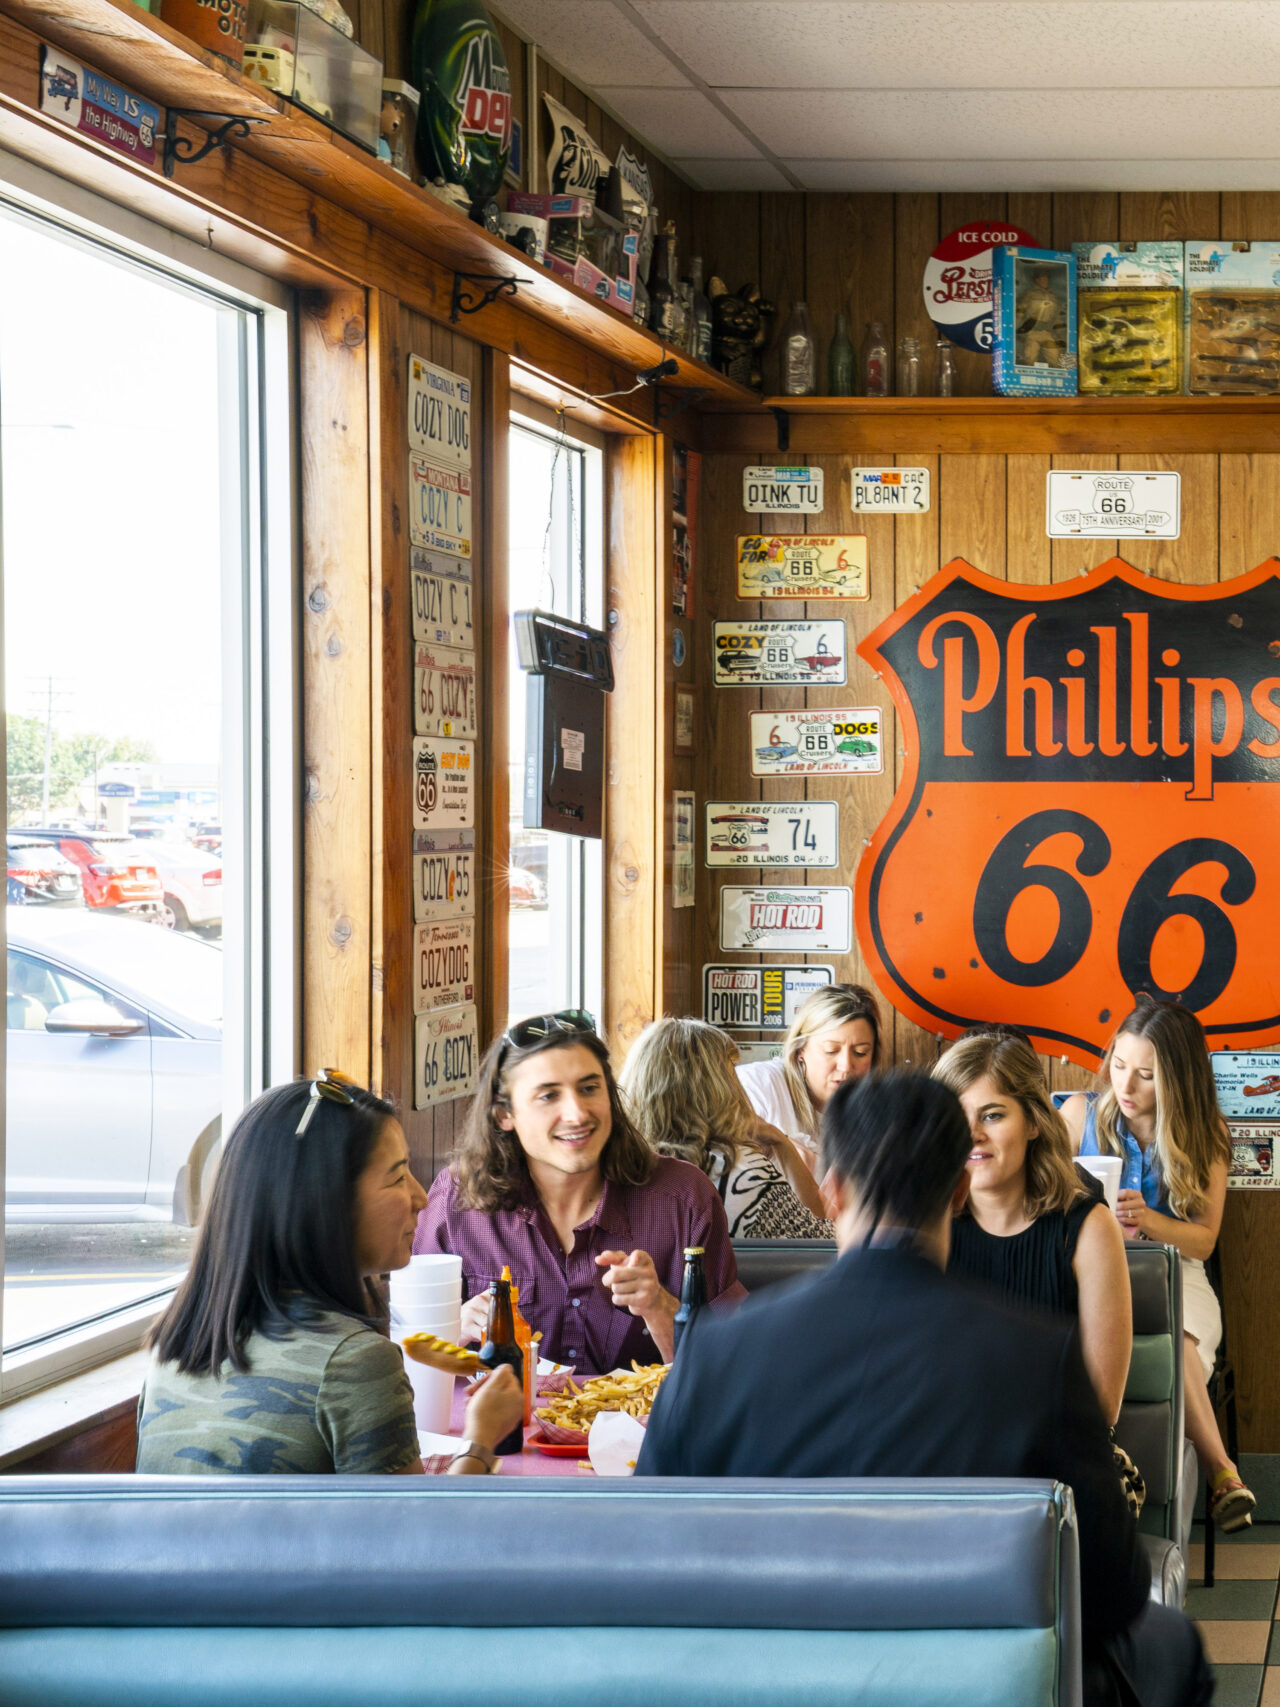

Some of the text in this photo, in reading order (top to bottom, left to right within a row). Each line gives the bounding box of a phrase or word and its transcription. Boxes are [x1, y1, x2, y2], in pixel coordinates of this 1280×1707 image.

[218, 16, 243, 43] OIL
[88, 76, 140, 118] My Way IS
[86, 106, 138, 151] the Highway
[958, 231, 1019, 243] ICE COLD
[425, 372, 456, 398] VIRGINIA
[414, 391, 469, 450] COZY DOG
[428, 468, 460, 493] MONTANA
[904, 474, 923, 484] CAL
[1098, 481, 1130, 489] ROUTE
[749, 485, 818, 503] OINK TU
[421, 485, 463, 533] COZY C
[1101, 498, 1126, 513] 66
[1101, 515, 1145, 526] ANNIVERSARY
[791, 561, 813, 576] 66
[837, 550, 848, 571] 6
[415, 575, 458, 626] COZY C
[716, 636, 766, 649] COZY
[817, 634, 828, 655] 6
[767, 649, 788, 662] 66
[421, 670, 468, 719] 66 COZY
[798, 714, 833, 722] ILLINOIS
[806, 725, 827, 733] ROUTE
[834, 722, 878, 735] DOGS
[769, 725, 781, 747] 6
[805, 735, 828, 750] 66
[418, 773, 435, 807] 66
[731, 833, 747, 845] 66
[788, 819, 816, 851] 74
[422, 856, 469, 901] COZY 55
[752, 905, 821, 929] HOT ROD
[972, 808, 1257, 1014] 66
[420, 944, 469, 990] COZYDOG
[713, 974, 758, 989] HOT ROD
[763, 970, 782, 1013] TOUR
[711, 992, 758, 1022] POWER
[431, 1015, 463, 1037] Illinois
[764, 1015, 782, 1025] 2006
[424, 1034, 473, 1088] 66 COZY
[1238, 1129, 1250, 1137] 20
